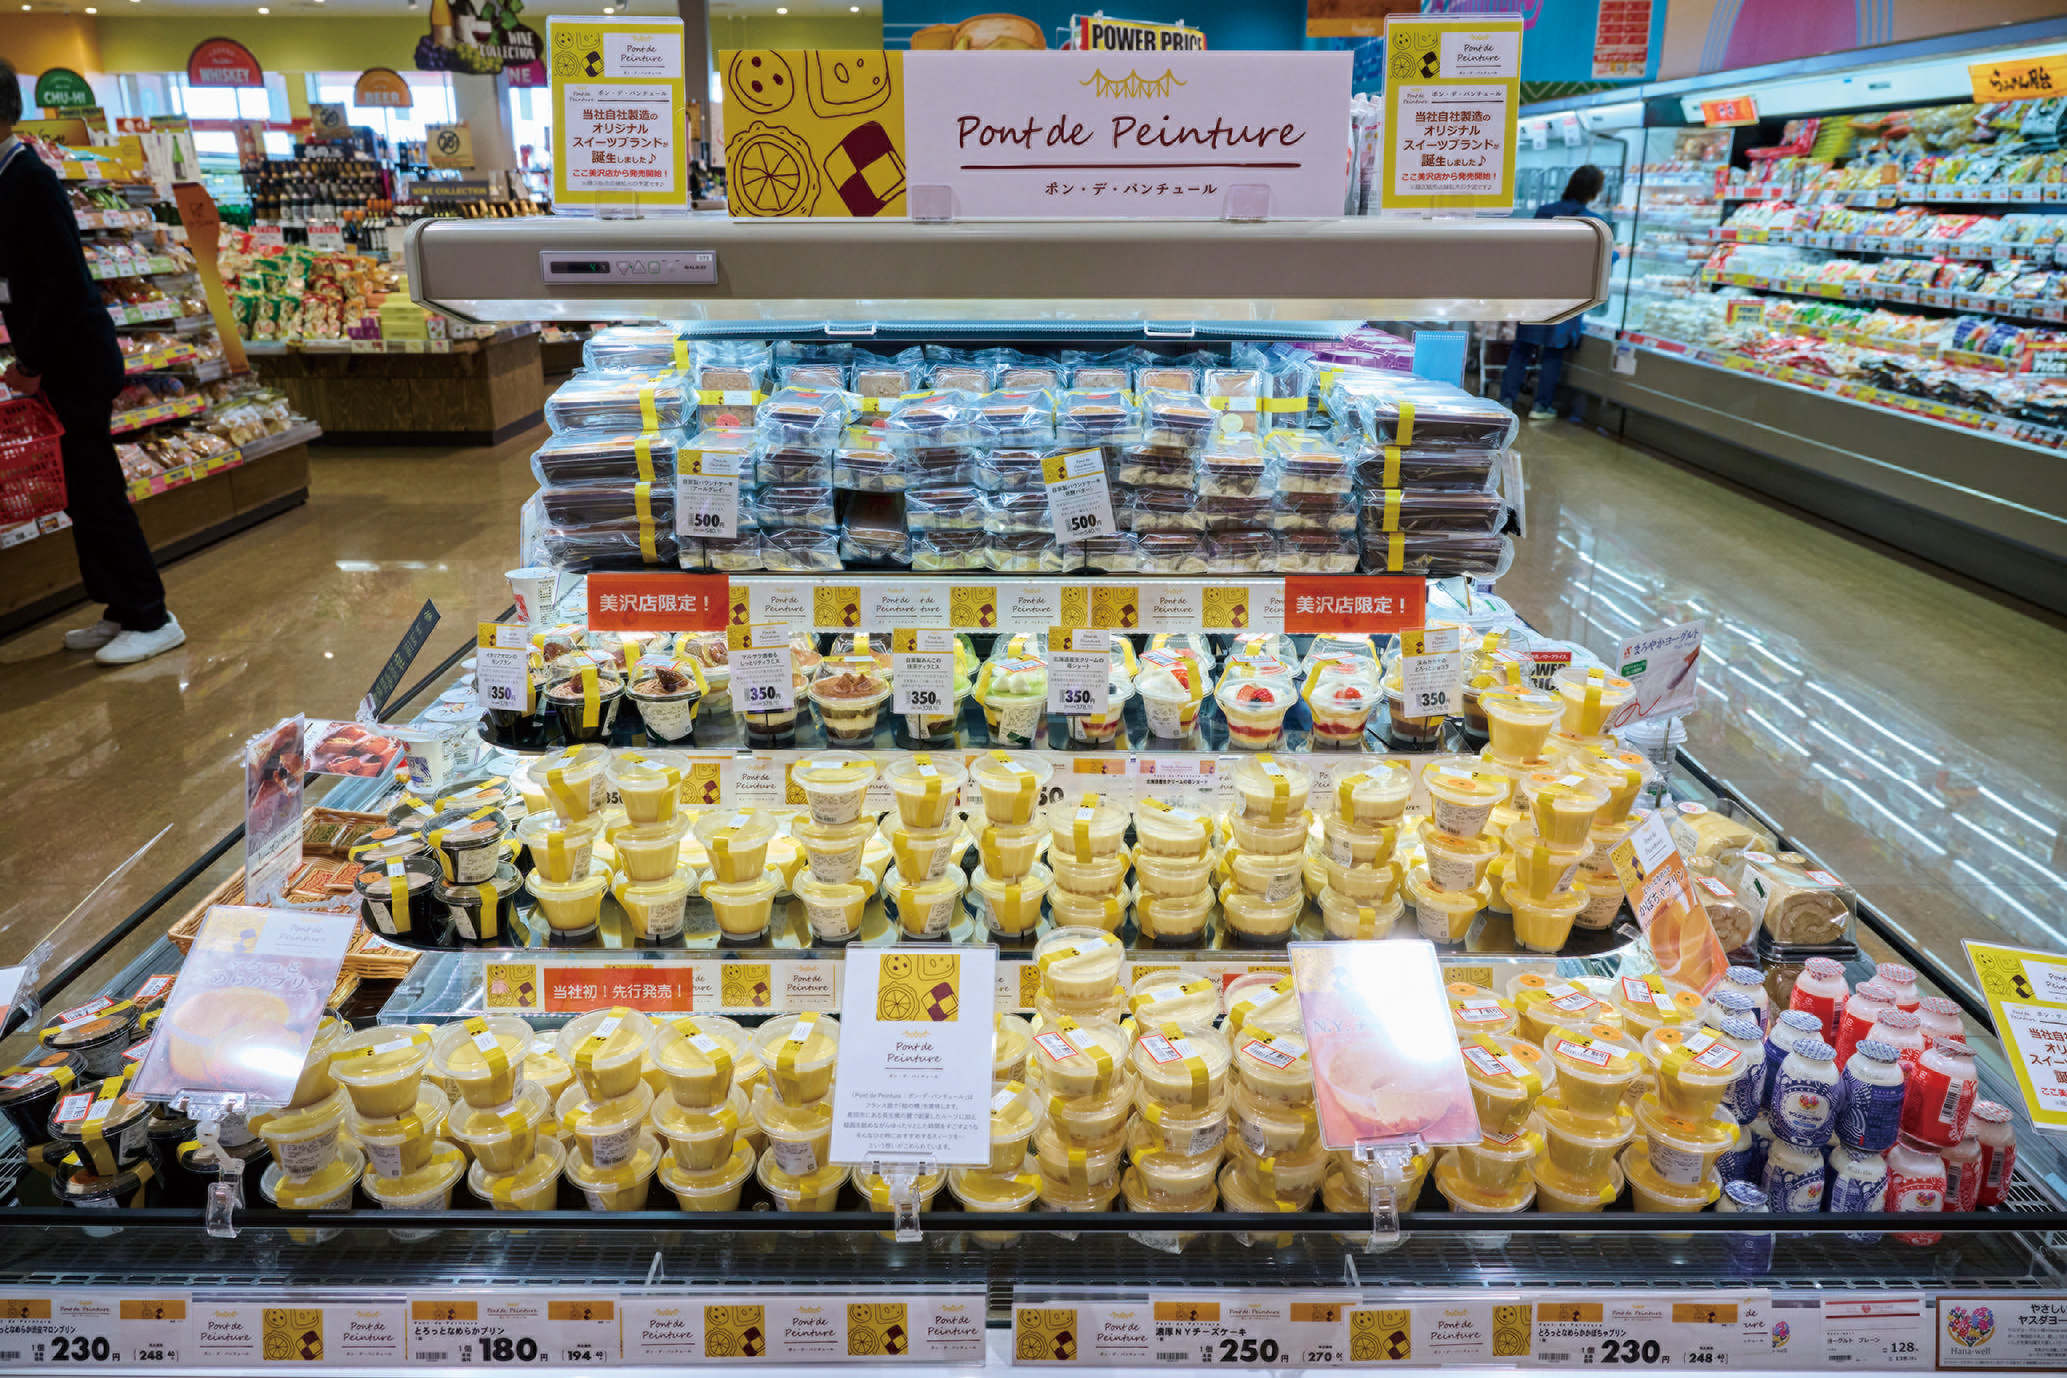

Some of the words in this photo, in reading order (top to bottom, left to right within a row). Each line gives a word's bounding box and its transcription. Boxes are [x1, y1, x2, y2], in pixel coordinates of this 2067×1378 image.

[508, 31, 534, 46] WINE
[1092, 24, 1157, 50] POWER
[626, 44, 644, 53] Pont
[644, 44, 657, 53] de
[1464, 44, 1482, 52] Pont
[1483, 43, 1495, 52] de
[620, 54, 663, 62] Peinture
[1457, 53, 1500, 62] Peinture
[199, 68, 250, 83] WHISKEY
[43, 91, 86, 105] CHU-HI
[364, 91, 400, 105] BEER
[583, 109, 658, 120] 当社自社製造の
[1415, 111, 1491, 123] 当社自社製造の
[592, 123, 649, 134] オリジナル
[957, 115, 1043, 149] Pont
[1047, 113, 1095, 147] de
[1112, 115, 1306, 150] Peinture
[1424, 125, 1480, 136] オリジナル
[572, 137, 669, 148] スイーツブランドが
[1403, 138, 1500, 151] スイーツブランドが
[572, 169, 668, 178] ここ美沢店から発売開始！
[1401, 172, 1497, 181] ここ美沢店から発売開始！
[438, 186, 488, 196] COLLECTION
[1045, 182, 1218, 197] ポン・デ・パンチュール
[599, 593, 710, 613] 美沢店限定！
[770, 595, 786, 604] Pont
[787, 595, 799, 604] de
[881, 596, 898, 605] Pont
[1018, 596, 1035, 605] Pont
[1159, 597, 1176, 605] Pont
[1176, 596, 1188, 605] de
[1270, 597, 1285, 605] Pon
[1295, 595, 1405, 615] 美沢店限定！
[764, 604, 805, 612] Peinture
[875, 604, 916, 613] Peinture
[1012, 604, 1053, 613] Peinture
[1153, 605, 1194, 614] Peinture
[1264, 605, 1285, 614] Pein
[1633, 628, 1700, 656] まろやかヨーグルト
[742, 772, 759, 782] Pont
[759, 772, 771, 781] de
[735, 781, 777, 790] Peinture
[792, 974, 810, 984] Pont
[810, 974, 823, 983] de
[786, 984, 830, 993] Peinture
[896, 1042, 920, 1051] Pont
[920, 1042, 934, 1051] de
[887, 1053, 943, 1063] Peinture
[649, 1317, 668, 1329] Pont
[669, 1317, 686, 1328] de
[792, 1316, 811, 1328] Pont
[812, 1316, 829, 1327] de
[934, 1314, 954, 1326] Pont
[955, 1314, 972, 1325] de
[1437, 1319, 1456, 1330] Pont
[1457, 1319, 1474, 1329] de
[207, 1321, 230, 1332] Pont
[230, 1321, 244, 1331] de
[350, 1321, 372, 1332] Pont
[373, 1321, 386, 1331] de
[414, 1327, 505, 1335] とろっとなめらかプリン
[785, 1326, 836, 1338] Peinture
[927, 1325, 979, 1337] Peinture
[1103, 1322, 1125, 1332] Pont
[1126, 1322, 1141, 1331] de
[200, 1332, 252, 1343] Peinture
[343, 1332, 394, 1343] Peinture
[642, 1328, 693, 1340] Peinture
[1096, 1332, 1149, 1343] Peinture
[1430, 1329, 1481, 1341] Peinture
